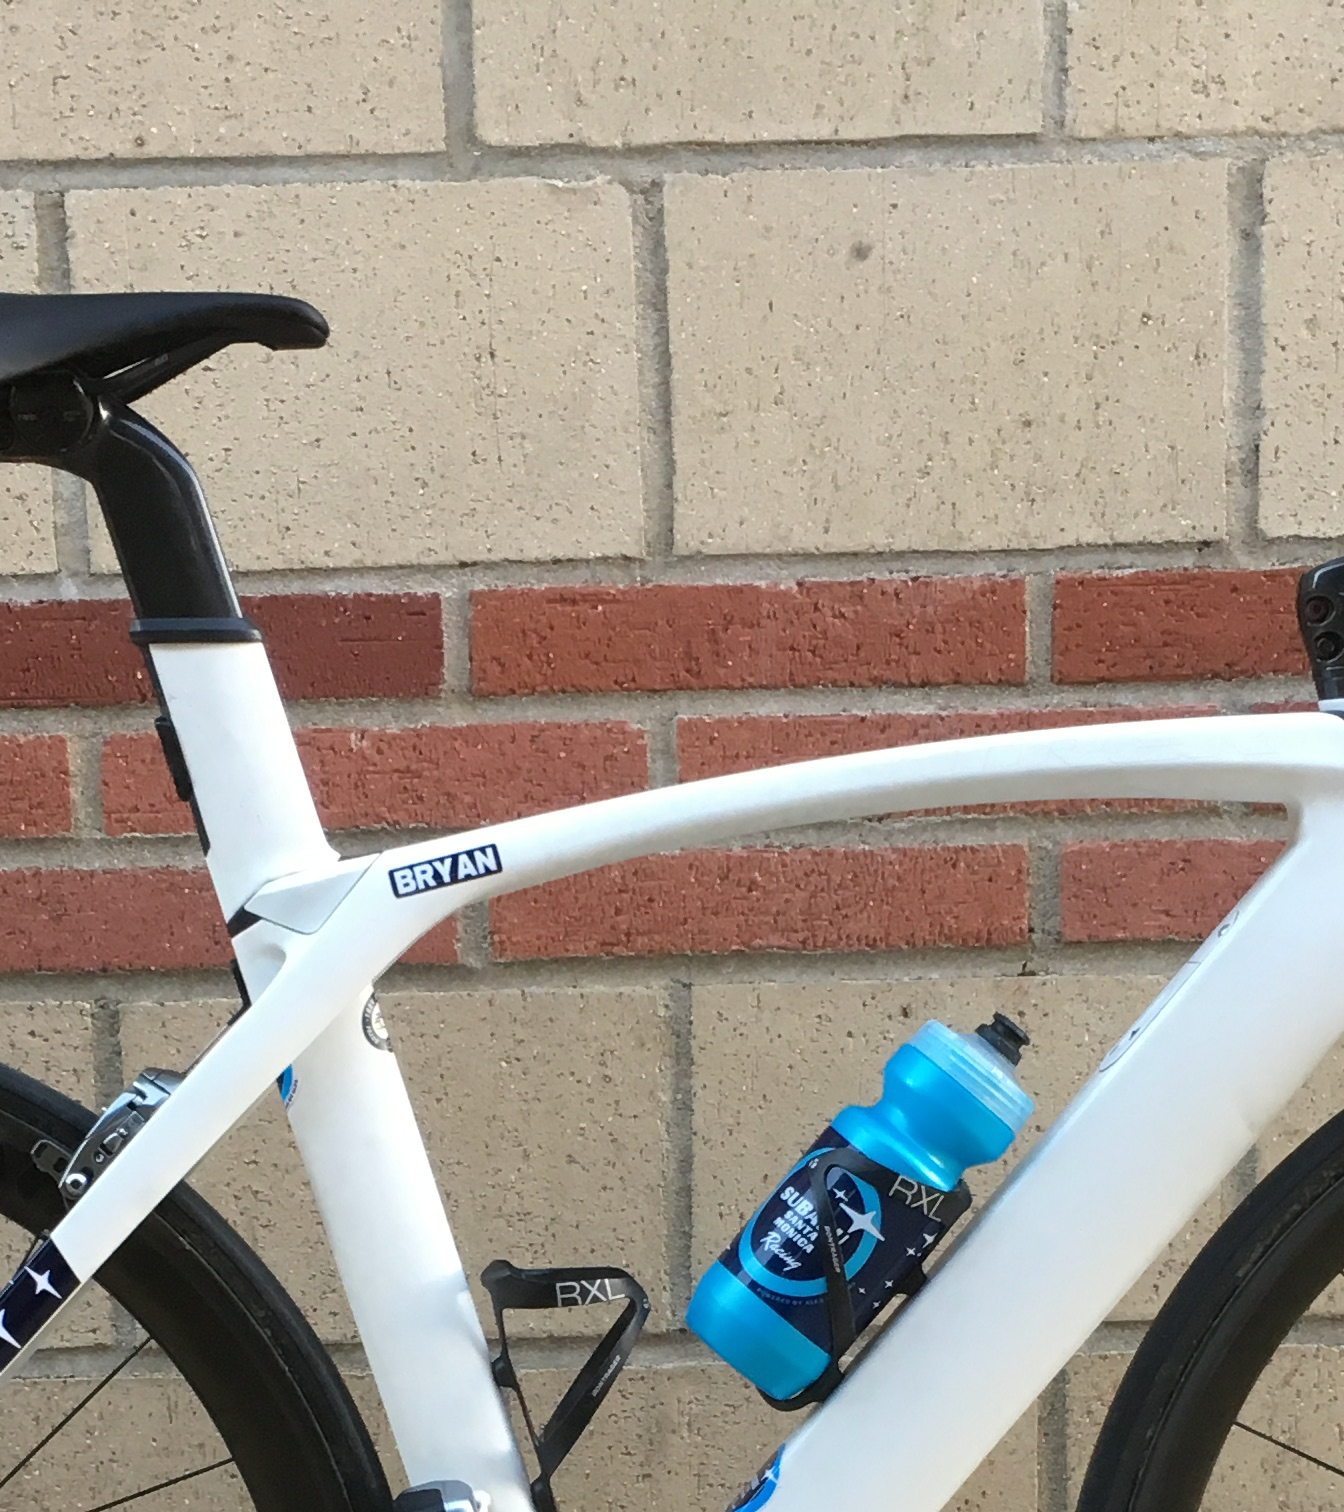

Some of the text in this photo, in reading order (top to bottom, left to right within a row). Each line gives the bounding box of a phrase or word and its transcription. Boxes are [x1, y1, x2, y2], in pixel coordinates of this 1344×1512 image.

[393, 847, 498, 895] BRYAN
[888, 1175, 945, 1222] RXL
[773, 1217, 815, 1254] MONICA
[784, 1210, 819, 1241] SANTA
[760, 1231, 802, 1272] Racing
[555, 1278, 625, 1307] RXL
